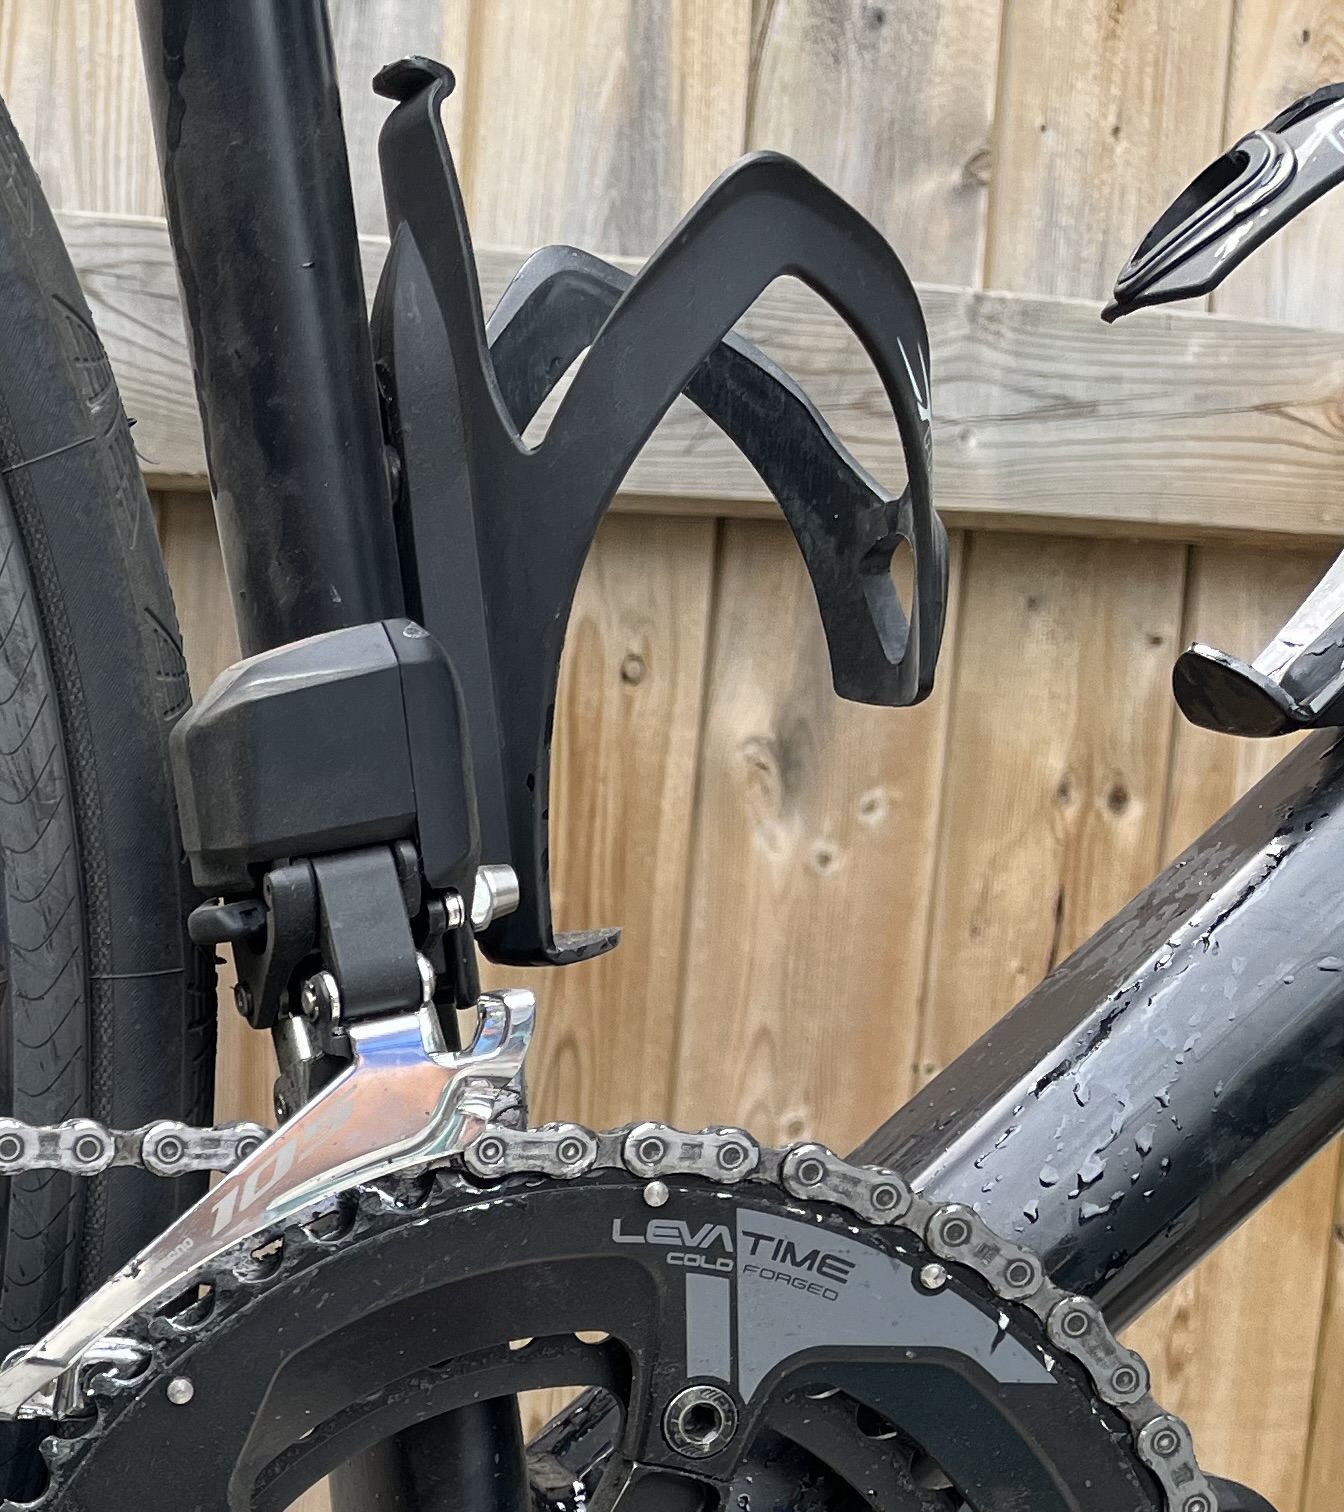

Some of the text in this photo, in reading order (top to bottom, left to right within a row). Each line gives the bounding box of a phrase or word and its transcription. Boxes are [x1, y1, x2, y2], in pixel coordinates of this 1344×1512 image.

[211, 1086, 357, 1238] 105
[666, 1251, 839, 1302] COLD FORGED
